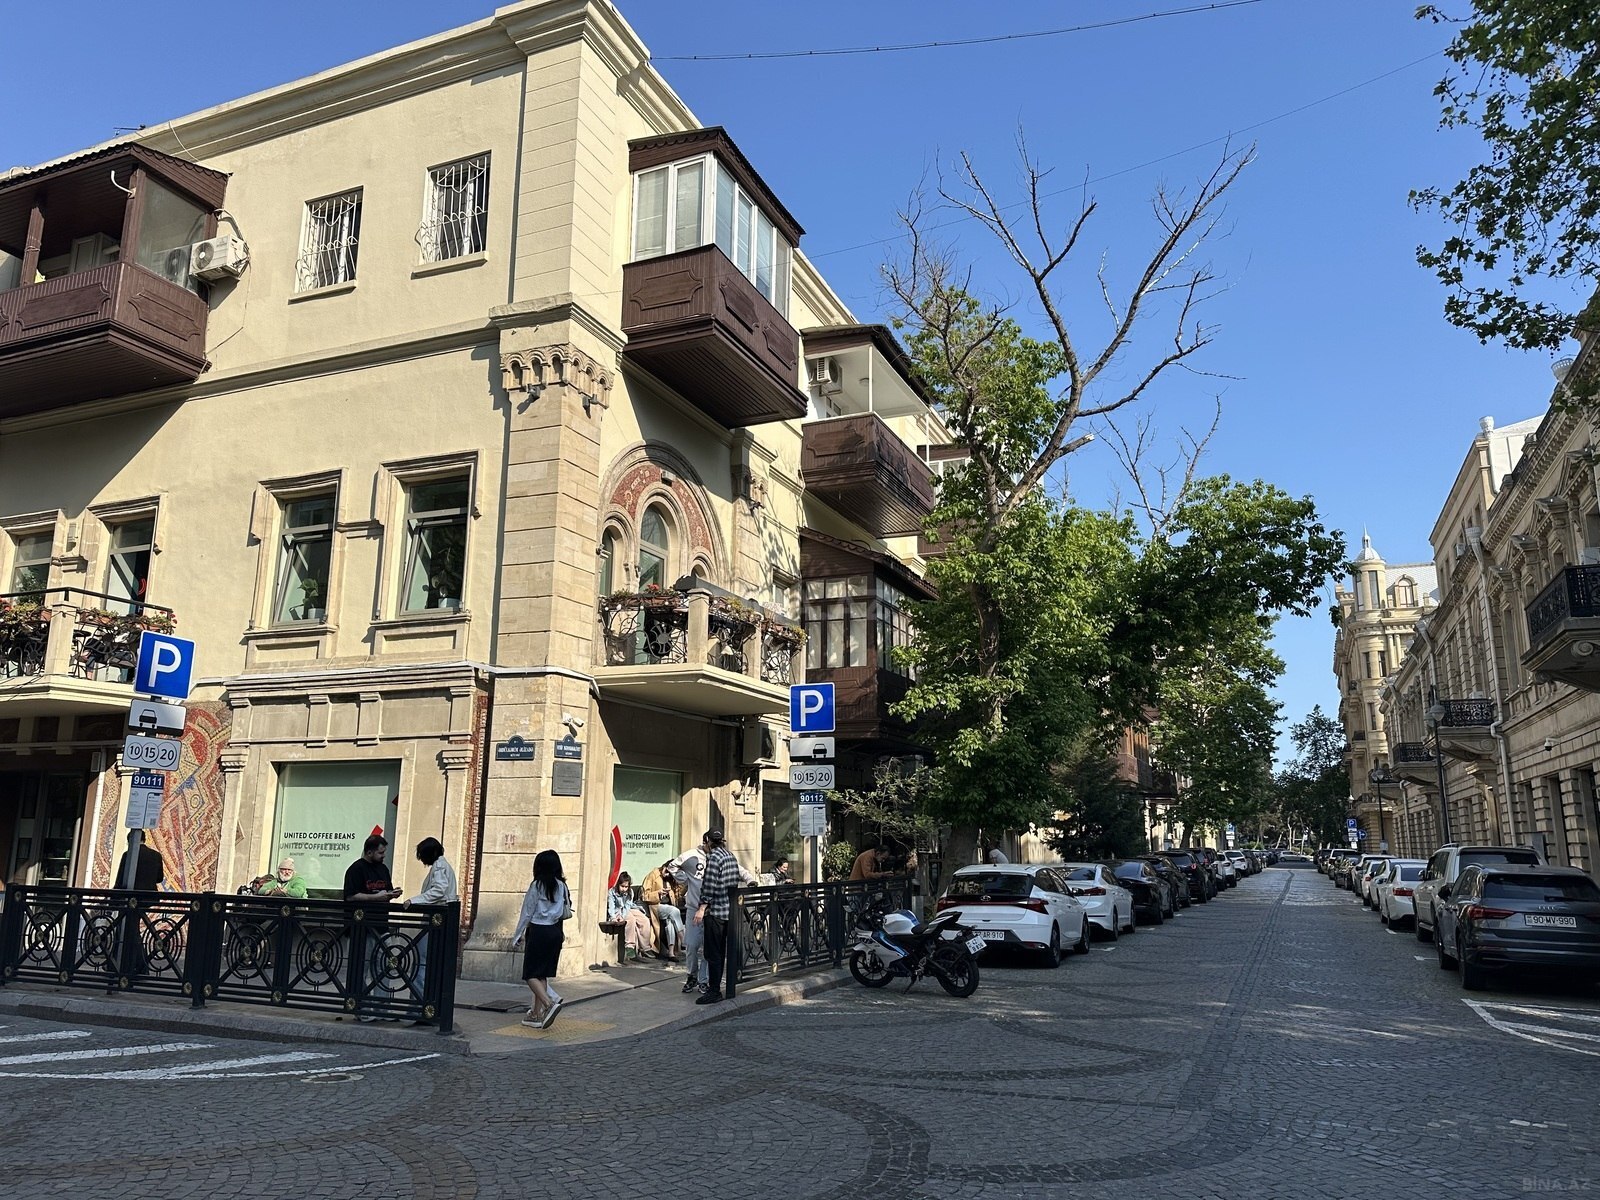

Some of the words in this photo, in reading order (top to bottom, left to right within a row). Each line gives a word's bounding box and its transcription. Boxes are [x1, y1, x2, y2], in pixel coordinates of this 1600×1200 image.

[148, 640, 182, 688] P
[800, 689, 824, 727] P
[129, 745, 141, 756] 10
[145, 746, 156, 759] 15
[160, 748, 175, 761] 20
[133, 775, 162, 786] 90111
[800, 794, 824, 802] 90112
[308, 832, 333, 840] COFFEE
[334, 832, 356, 840] BEANS
[658, 833, 670, 841] BEANS
